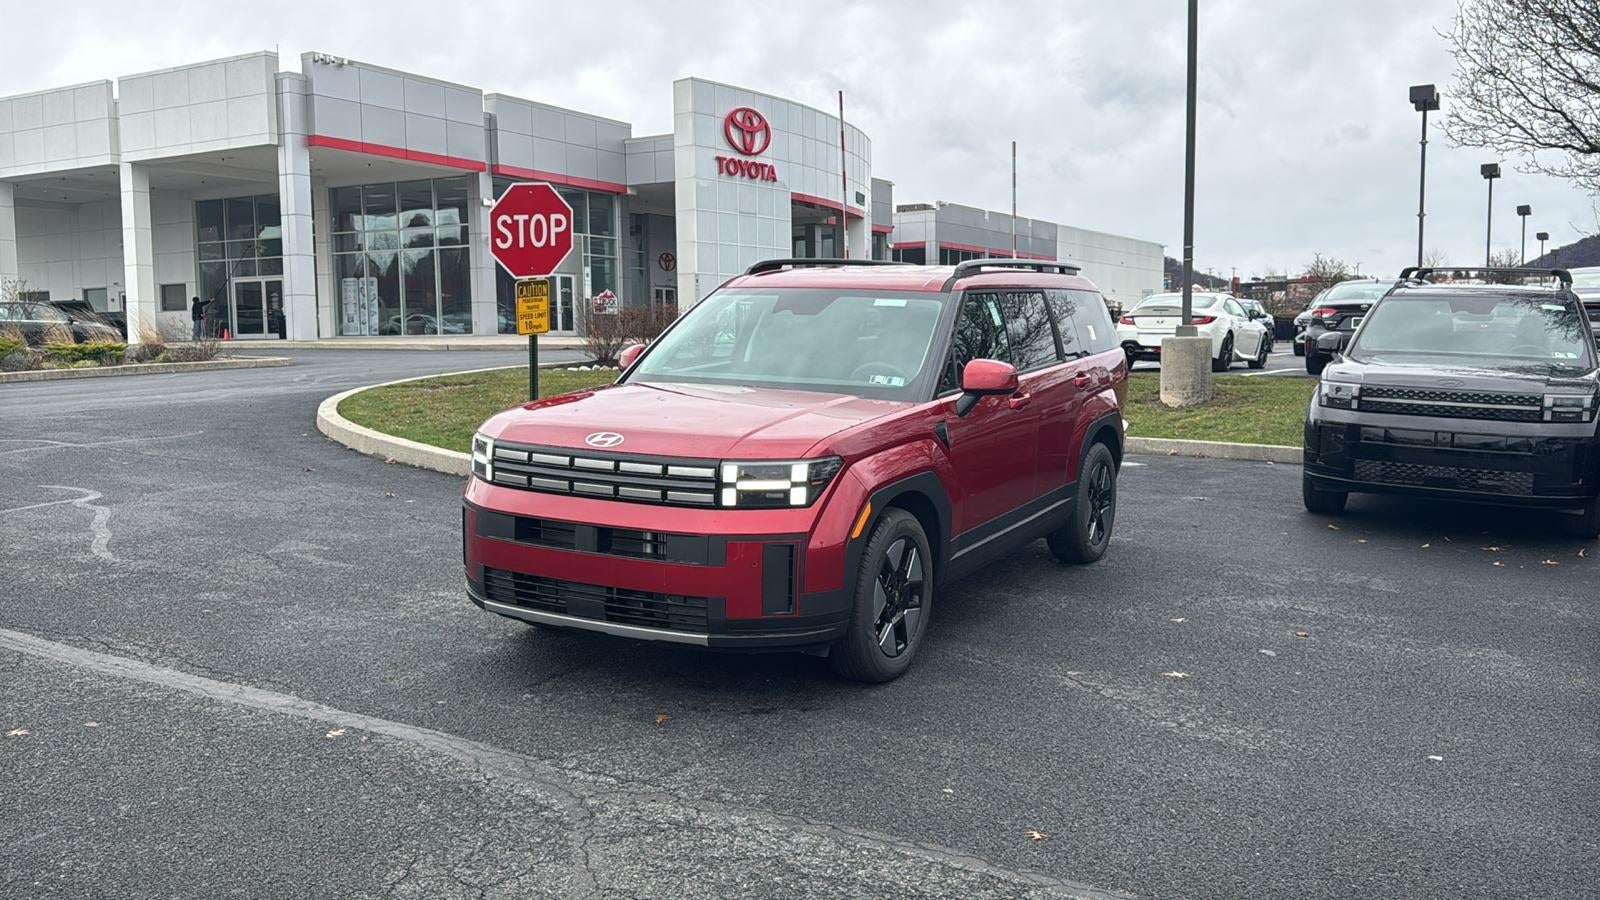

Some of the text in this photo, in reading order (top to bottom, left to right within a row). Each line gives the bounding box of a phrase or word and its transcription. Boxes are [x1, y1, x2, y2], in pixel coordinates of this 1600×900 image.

[715, 156, 777, 182] TOYOTA
[496, 213, 567, 249] STOP
[518, 284, 547, 297] CAUTION
